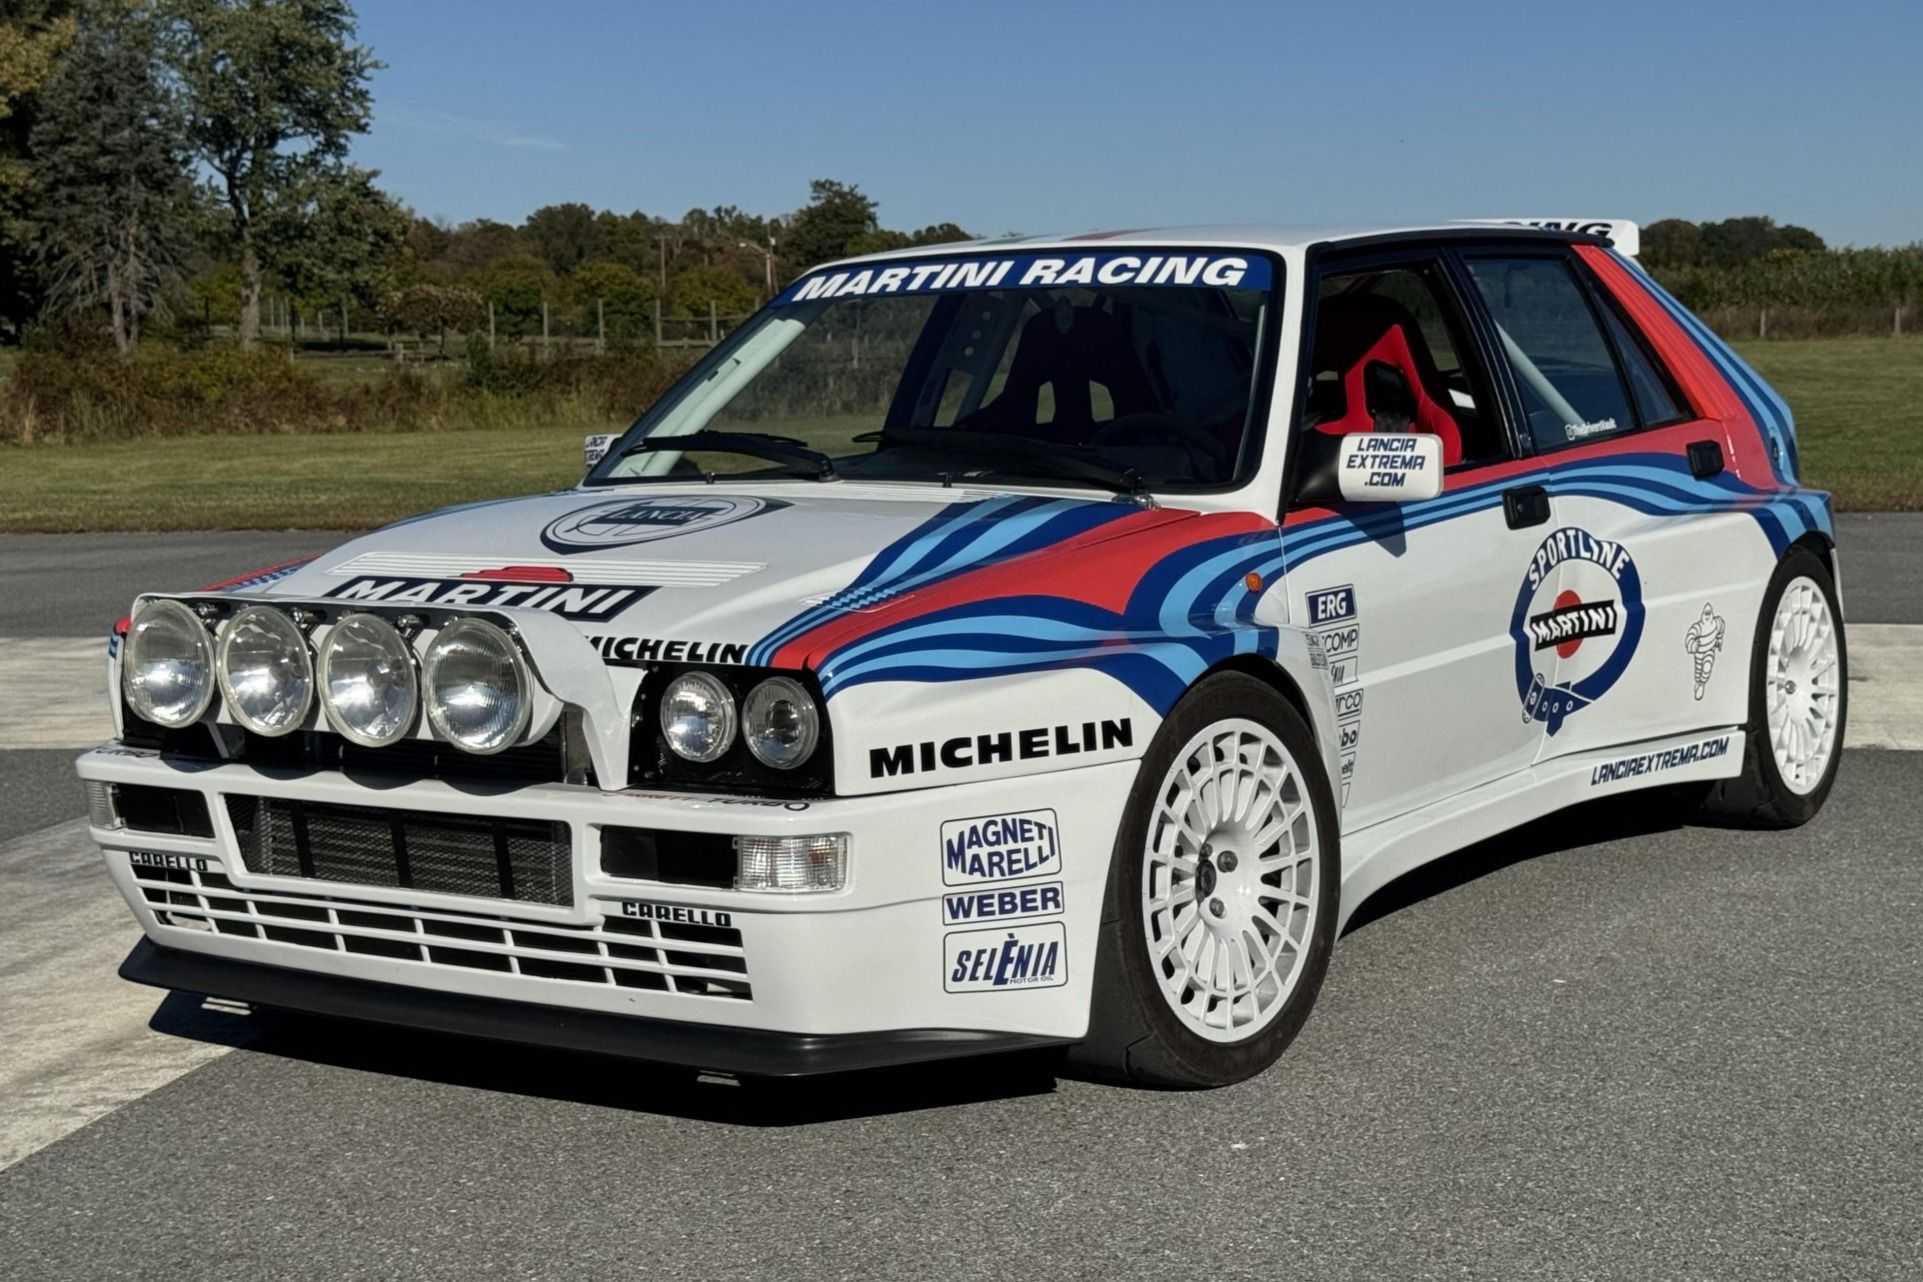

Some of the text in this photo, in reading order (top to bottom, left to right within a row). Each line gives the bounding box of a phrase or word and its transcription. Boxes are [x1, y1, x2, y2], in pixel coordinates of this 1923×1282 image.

[792, 256, 1249, 302] MARTINI RACING
[1357, 438, 1417, 452] LANCIA
[1346, 454, 1426, 470] EXTREMA
[1364, 472, 1406, 487] .COM
[338, 580, 635, 614] MARTINI
[1317, 592, 1347, 620] ERG
[1531, 606, 1616, 644] MARTINI
[869, 717, 1133, 779] MICHELIN
[1591, 736, 1730, 786] LANCIAEXTREMA.COM
[946, 818, 1055, 858] MAGNETI
[622, 901, 731, 927] CARELLO
[946, 887, 1061, 920] WEBER
[1009, 977, 1039, 985] MOTOR
